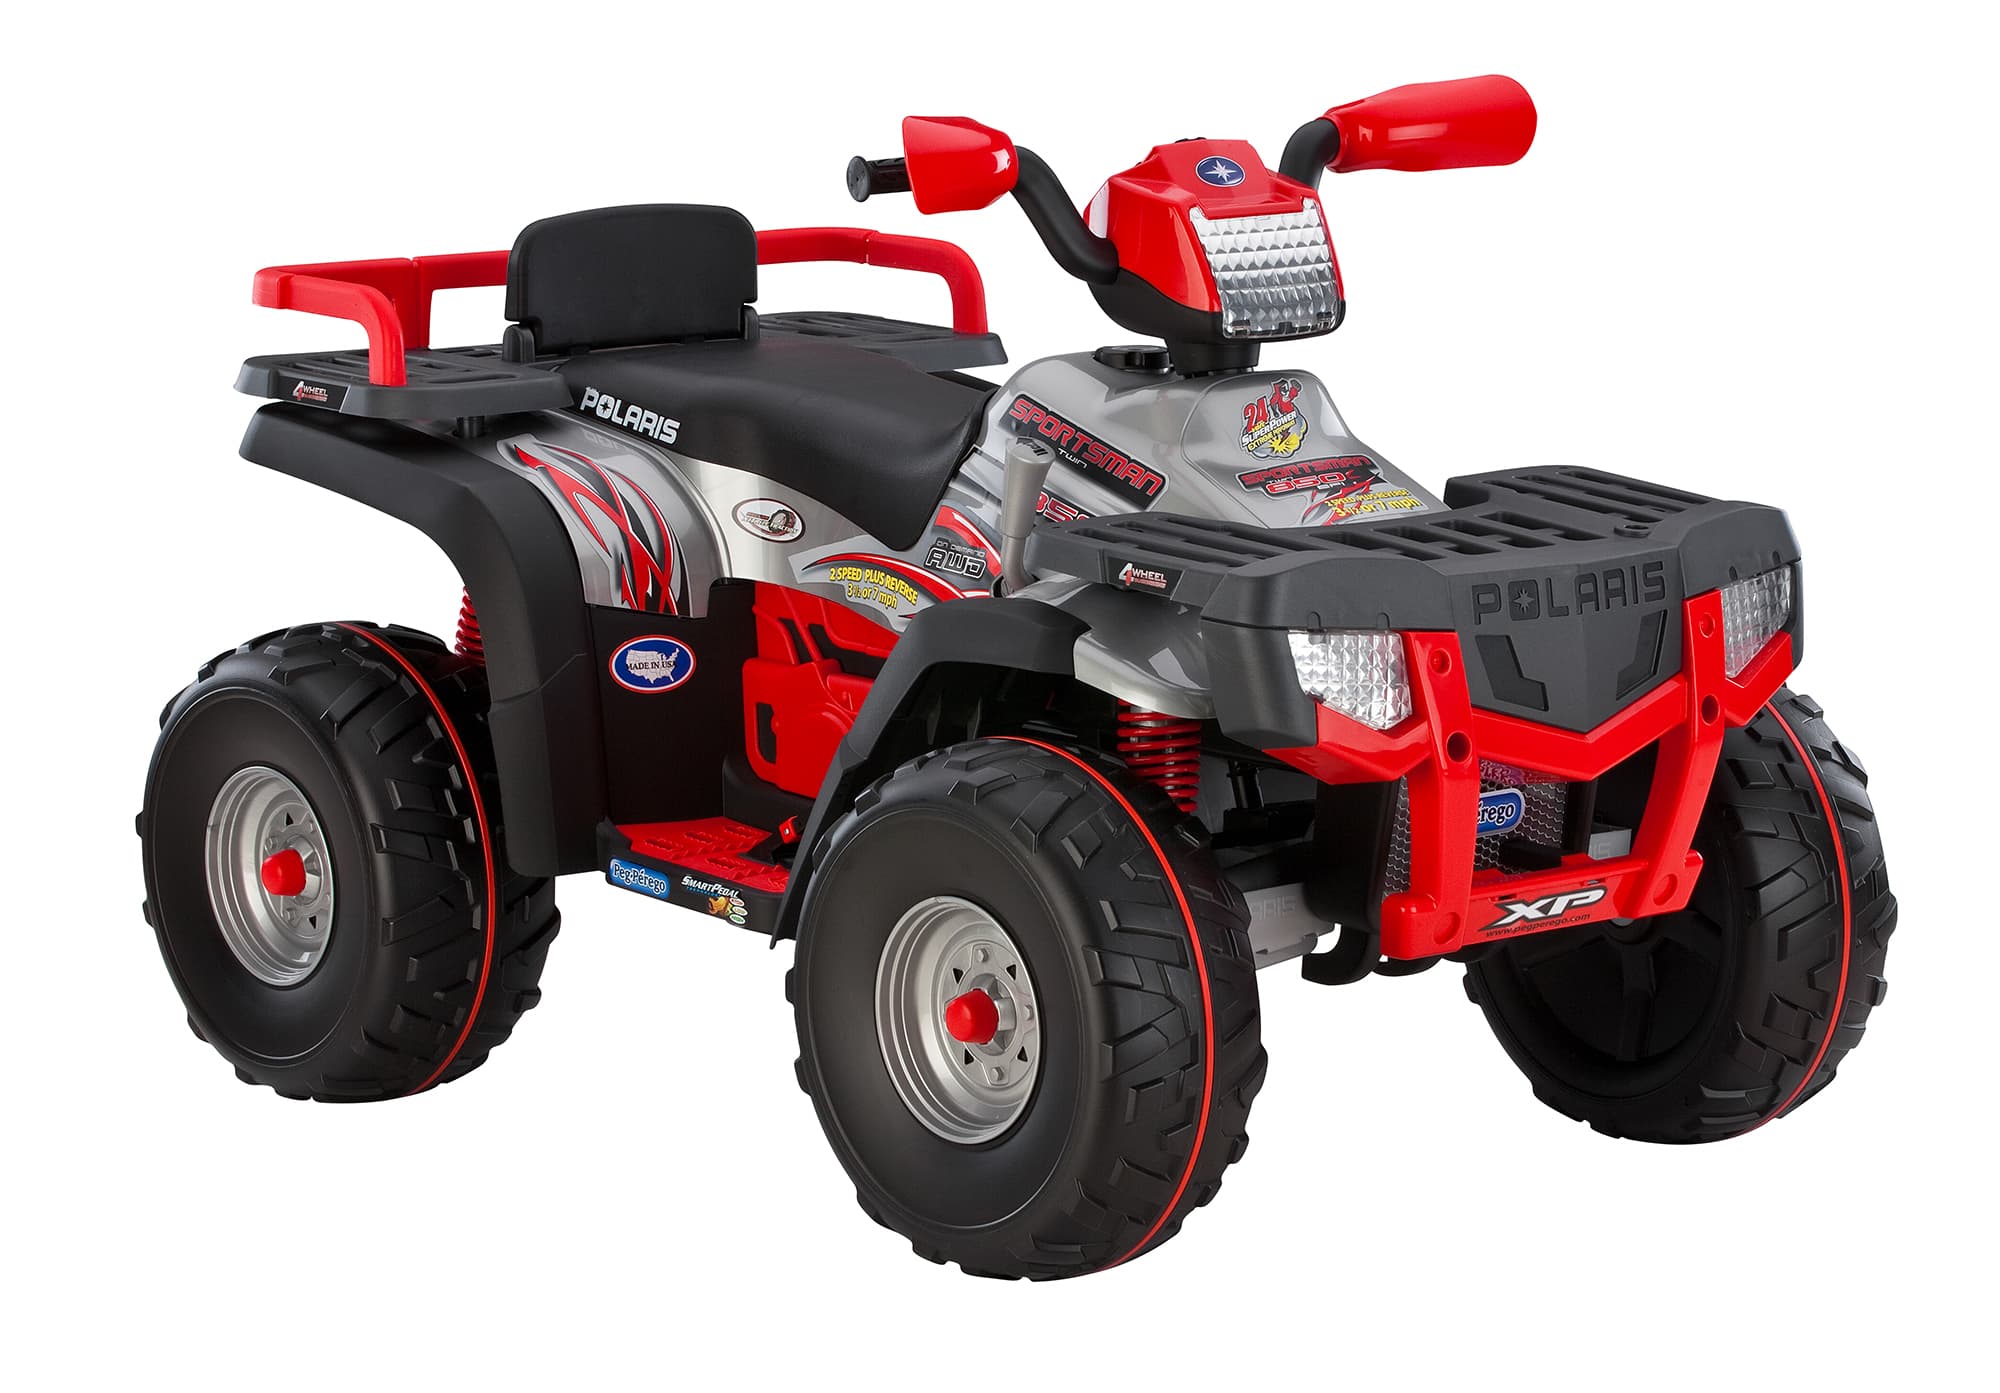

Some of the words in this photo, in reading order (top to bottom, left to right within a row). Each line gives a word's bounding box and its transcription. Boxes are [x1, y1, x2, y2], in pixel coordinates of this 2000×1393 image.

[303, 386, 328, 397] WHEEL
[579, 386, 681, 445] POLARIS
[1243, 396, 1269, 433] 24
[1008, 399, 1163, 496] SPORTSMAN
[1241, 456, 1372, 486] SPORTSMAN
[1265, 472, 1347, 494] 850
[1360, 503, 1377, 513] or
[1374, 500, 1388, 510] 7
[1387, 496, 1422, 511] mph
[925, 547, 987, 579] AWD
[1118, 562, 1135, 587] 4
[1132, 567, 1168, 583] WHEEL
[829, 567, 836, 581] 2
[837, 567, 862, 581] SPEED
[864, 568, 885, 586] PLUS
[885, 574, 919, 606] REVERSE
[861, 587, 873, 599] or
[873, 586, 879, 600] 7
[879, 591, 898, 610] mph
[1471, 560, 1666, 625] POLARIS
[626, 661, 649, 670] MADE
[662, 660, 676, 668] USA
[1480, 885, 1607, 930] XP
[1485, 913, 1591, 938] www.pegperego.com
